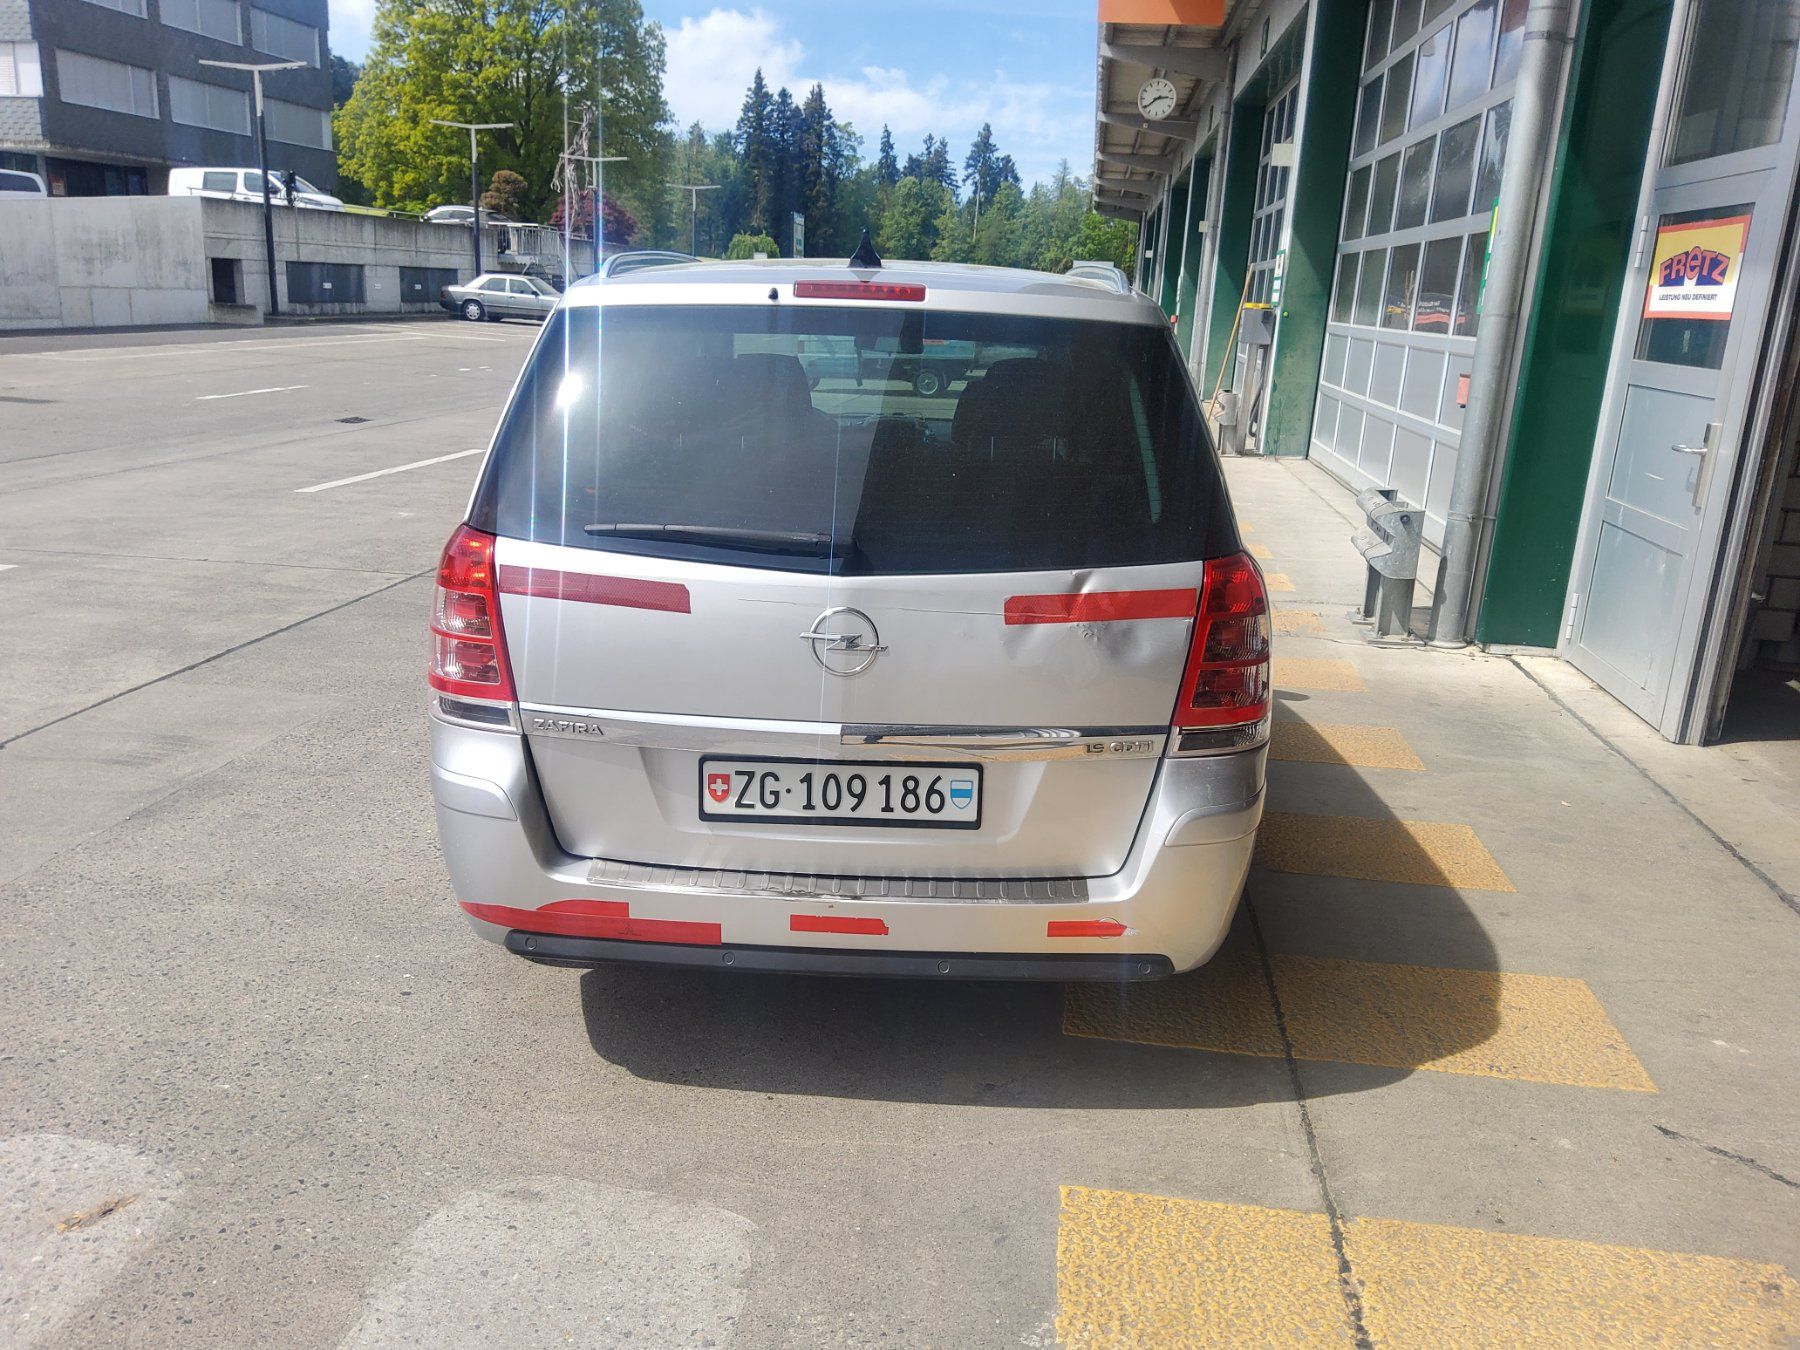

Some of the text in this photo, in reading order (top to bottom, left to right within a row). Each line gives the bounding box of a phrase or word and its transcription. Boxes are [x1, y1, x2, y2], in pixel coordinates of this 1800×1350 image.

[1658, 293, 1718, 301] LEISTUNG NEU DEFINIERT
[533, 718, 605, 736] ZAFIRA
[1109, 741, 1154, 754] CDTI
